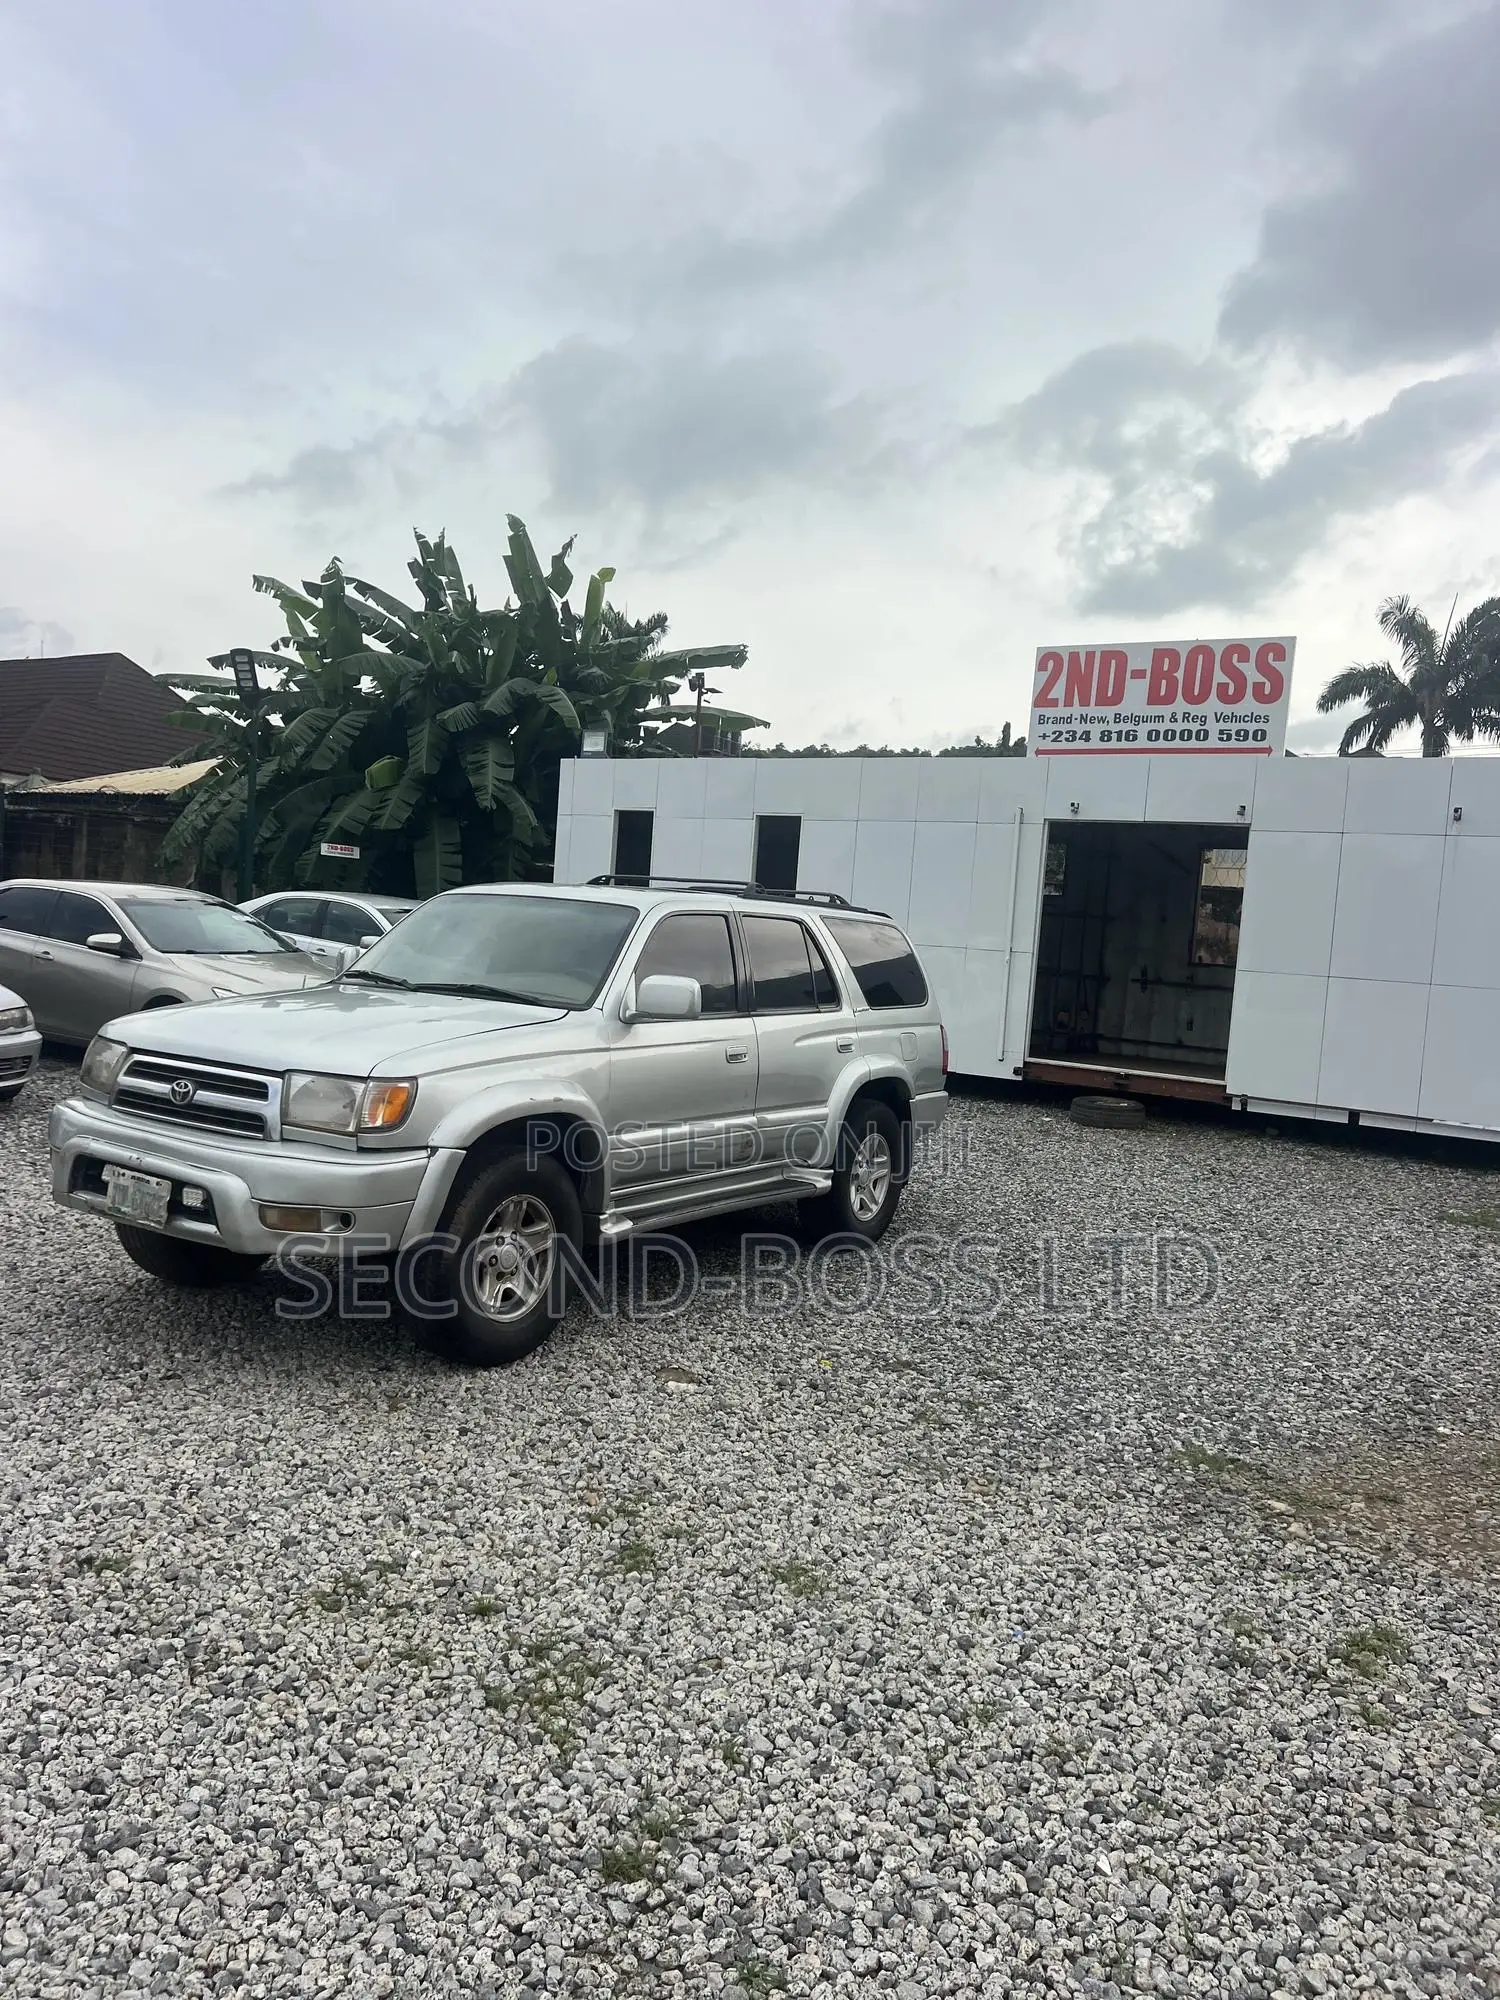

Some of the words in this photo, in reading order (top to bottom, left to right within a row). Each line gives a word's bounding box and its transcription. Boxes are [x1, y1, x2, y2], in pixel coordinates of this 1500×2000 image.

[1033, 642, 1286, 708] 2ND-BOSS
[1038, 713, 1110, 726] Brand-New,
[1113, 712, 1165, 726] Belguim
[1169, 711, 1178, 724] &
[1182, 711, 1208, 727] Reg
[1214, 711, 1270, 724] Vehicles
[1038, 729, 1092, 743] +234
[1099, 729, 1138, 743] 816
[1146, 728, 1209, 742] 0000
[1217, 728, 1267, 742] 590
